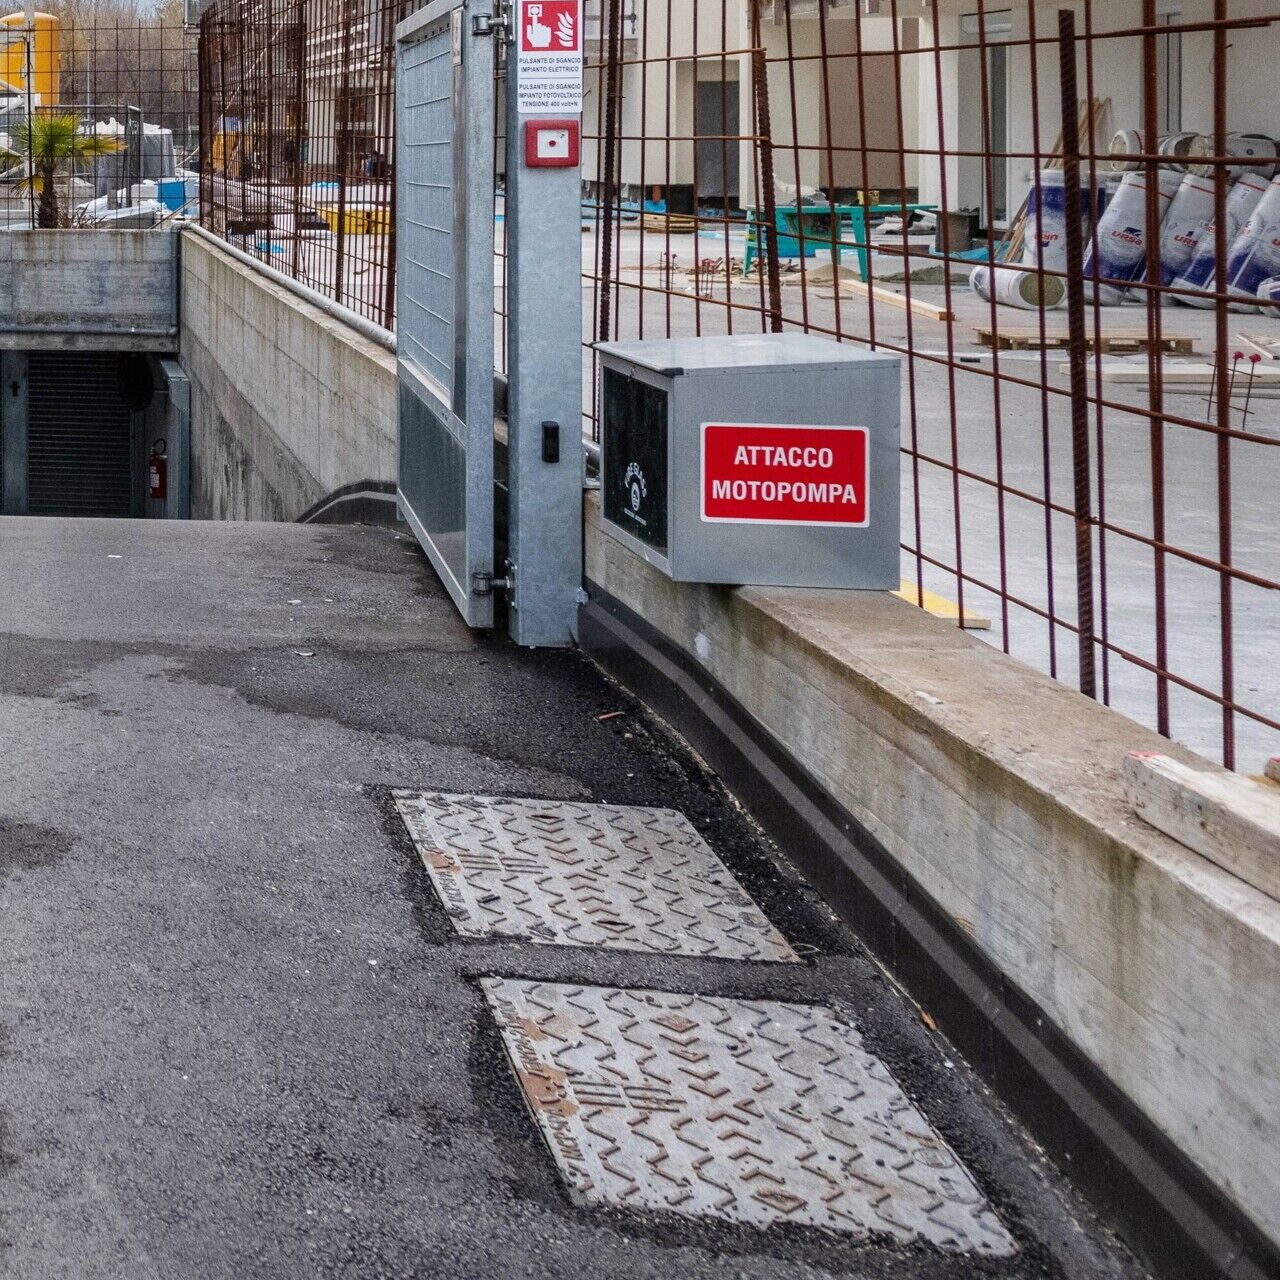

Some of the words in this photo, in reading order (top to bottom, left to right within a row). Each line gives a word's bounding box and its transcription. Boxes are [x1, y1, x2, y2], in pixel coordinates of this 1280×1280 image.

[1174, 234, 1199, 247] URS
[733, 445, 834, 469] ATTACCO
[711, 479, 858, 505] MOTOPOMPA
